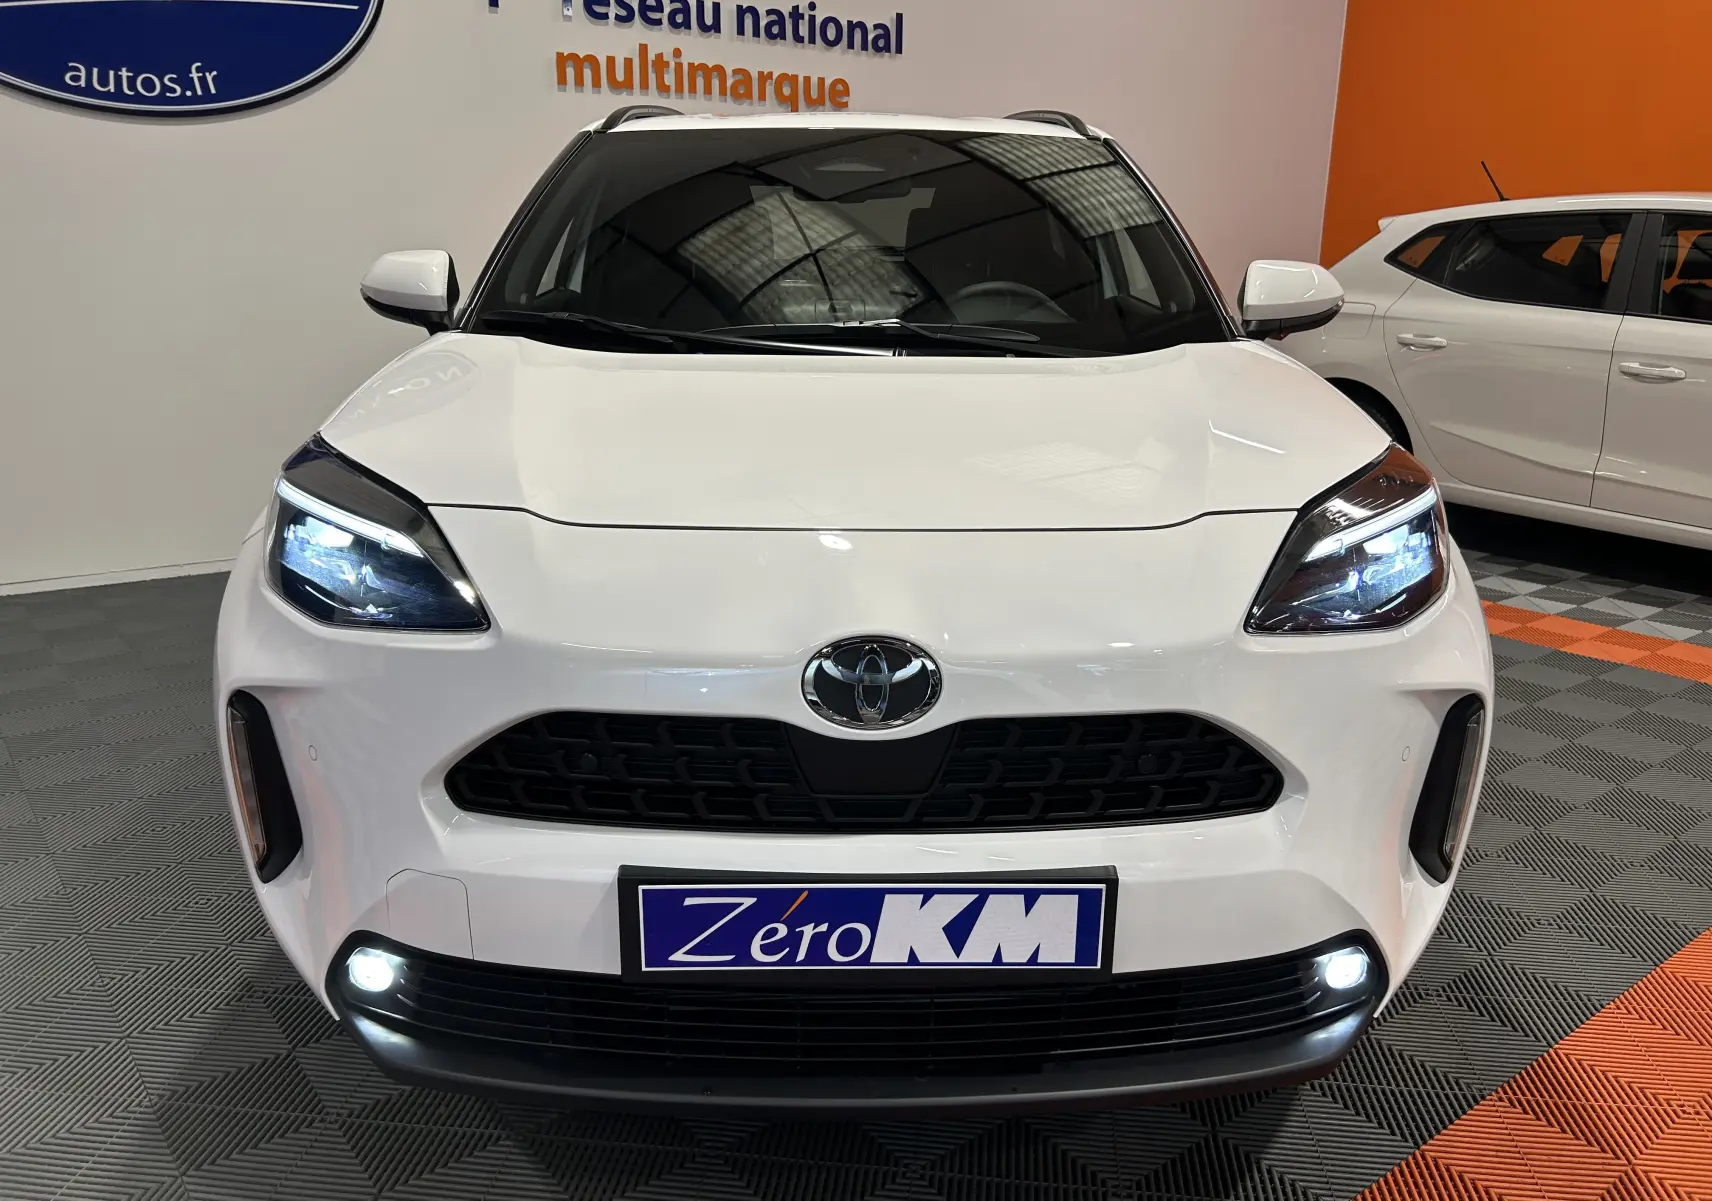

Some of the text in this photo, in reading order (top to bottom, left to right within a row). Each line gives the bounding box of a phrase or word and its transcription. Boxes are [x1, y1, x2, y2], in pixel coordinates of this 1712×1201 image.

[735, 2, 904, 55] national
[64, 62, 218, 97] autos.fr
[555, 43, 851, 112] multimarque
